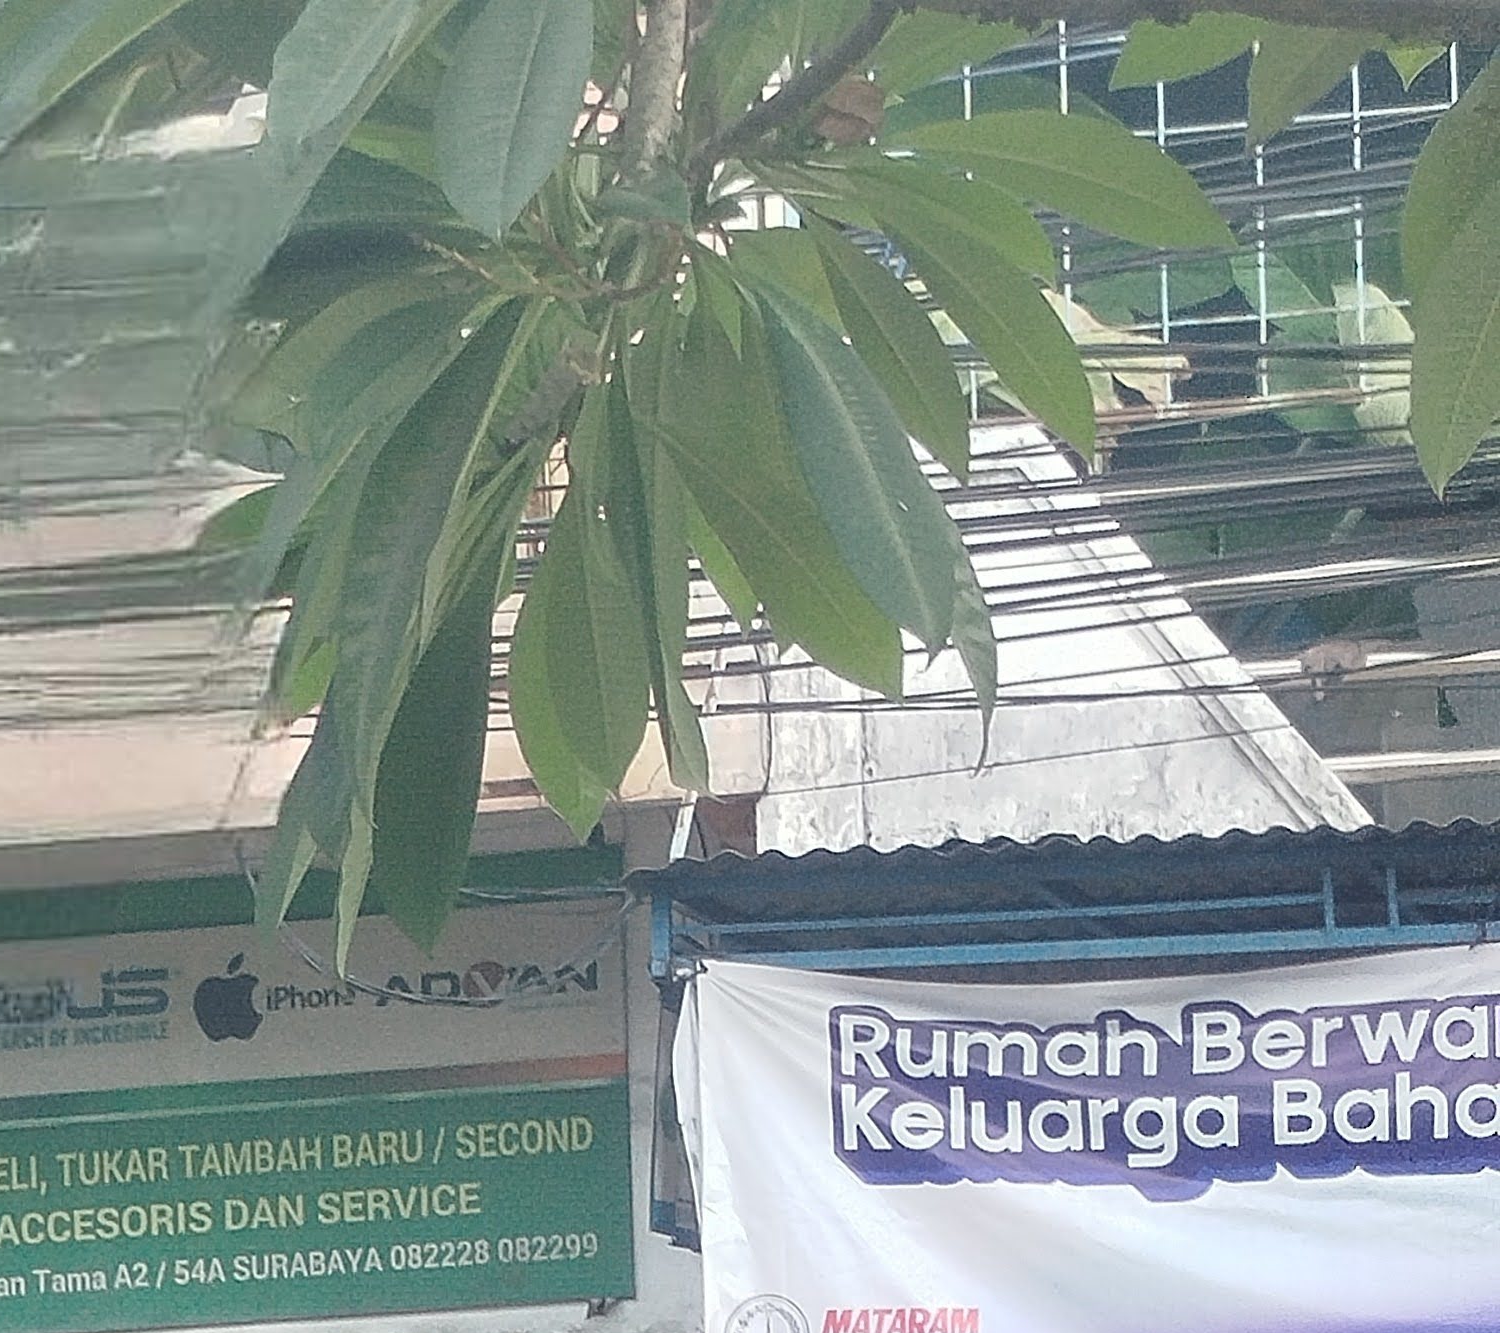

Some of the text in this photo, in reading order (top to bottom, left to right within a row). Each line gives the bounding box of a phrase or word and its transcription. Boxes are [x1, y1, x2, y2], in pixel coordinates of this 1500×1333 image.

[839, 1003, 1500, 1078] Rumah Berwa
[56, 1148, 170, 1187] TUKAR
[178, 1137, 323, 1178] TAMBAH
[332, 1129, 424, 1169] BARU
[432, 1127, 445, 1165] /
[456, 1116, 595, 1160] SECOND
[841, 1082, 1239, 1168] Keluarga
[224, 1194, 305, 1231] DAN
[317, 1182, 483, 1225] SERVICE
[31, 1268, 108, 1294] Tama
[114, 1262, 150, 1290] A2
[155, 1260, 167, 1290] /
[173, 1257, 226, 1285] 54A
[233, 1247, 384, 1282] SURABAYA
[390, 1238, 491, 1271] 082228
[497, 1231, 599, 1263] 082299
